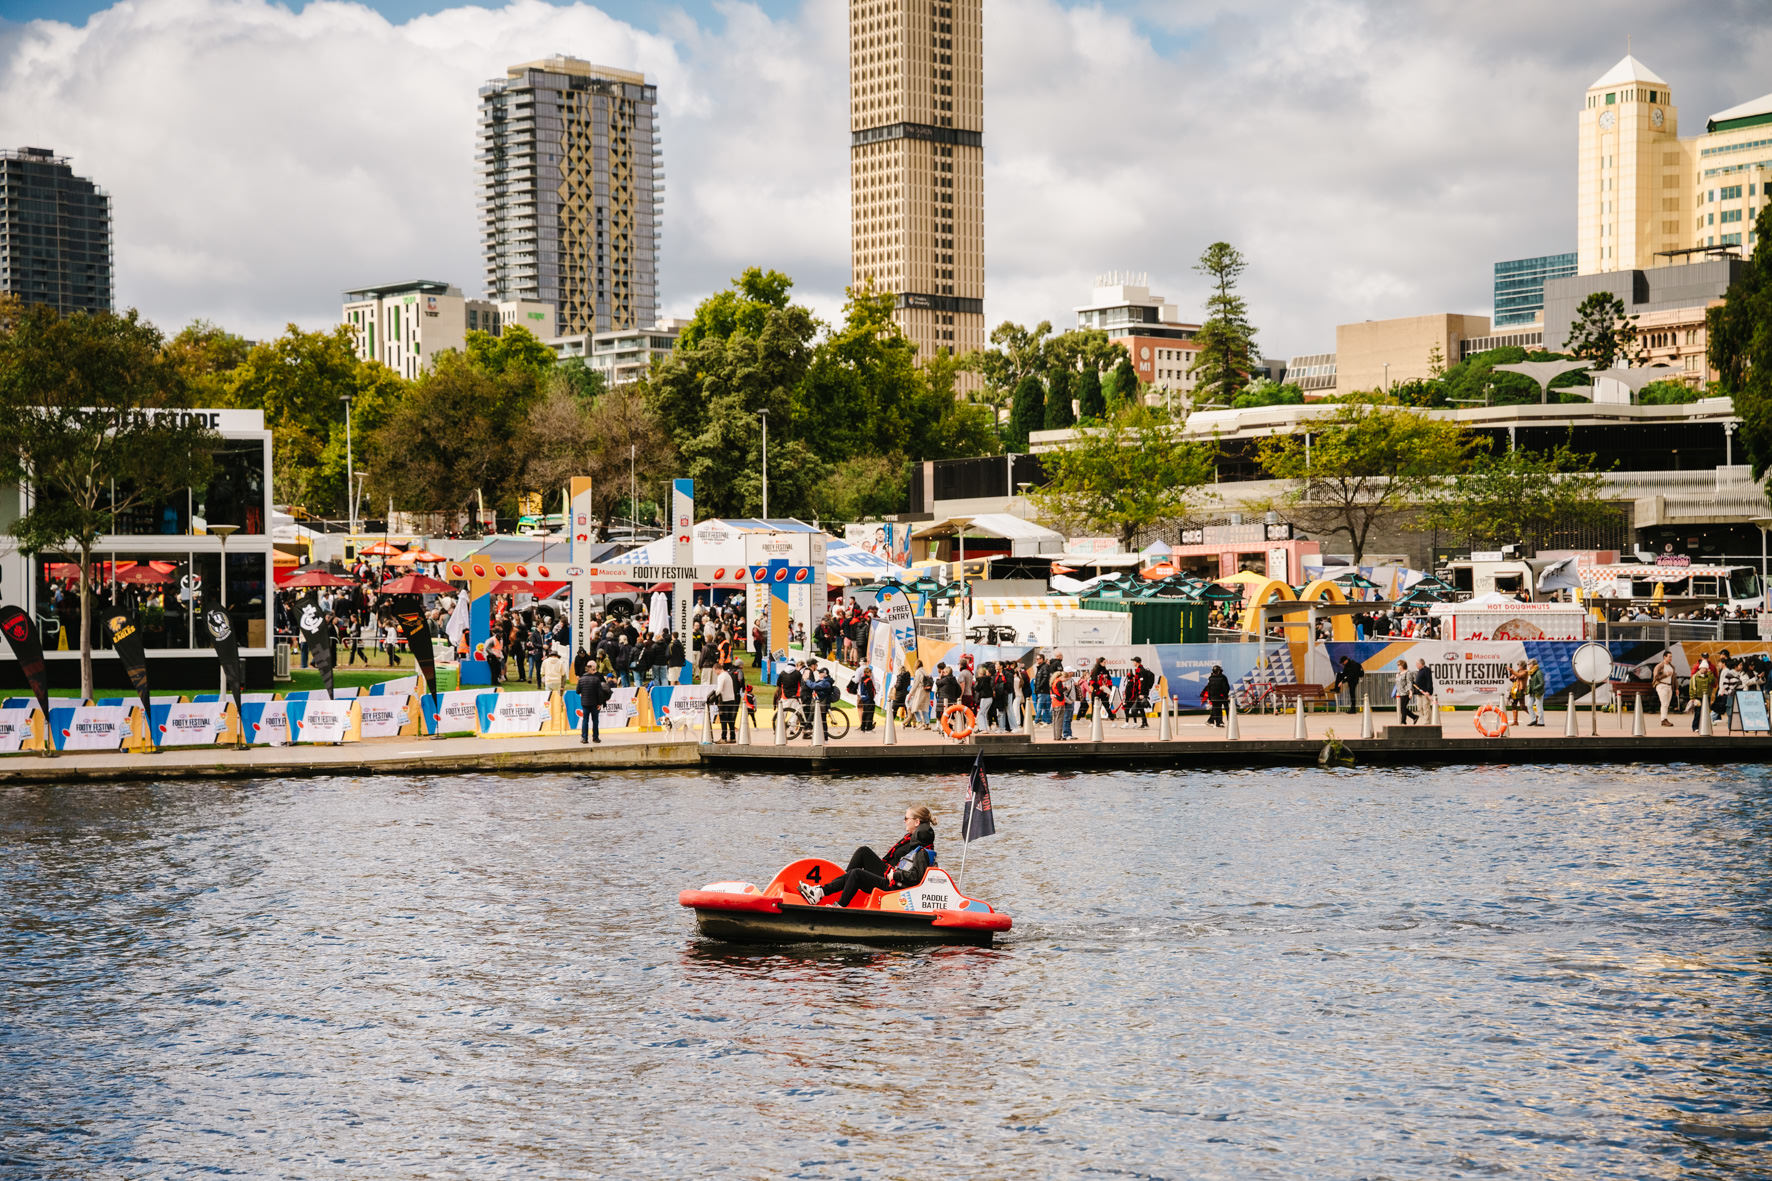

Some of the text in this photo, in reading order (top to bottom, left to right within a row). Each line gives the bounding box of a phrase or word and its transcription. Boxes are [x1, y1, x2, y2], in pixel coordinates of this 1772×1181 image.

[633, 566, 660, 579] FOOTY
[662, 566, 698, 579] FESTIVAL
[892, 604, 909, 613] FREE
[888, 612, 910, 621] ENTRY
[1429, 663, 1462, 679] FOOTY
[373, 711, 393, 719] FESTIVAL
[516, 707, 535, 715] FESTIVAL
[172, 718, 210, 726] FOOTY FESTIVAL
[266, 717, 281, 725] FOOTY
[308, 715, 338, 723] FOOTY FESTIVAL
[76, 723, 92, 732] FOOTY
[93, 723, 115, 731] FESTIVAL
[806, 865, 821, 883] 4
[922, 893, 949, 903] PADDLE
[922, 901, 948, 910] BATTLE
